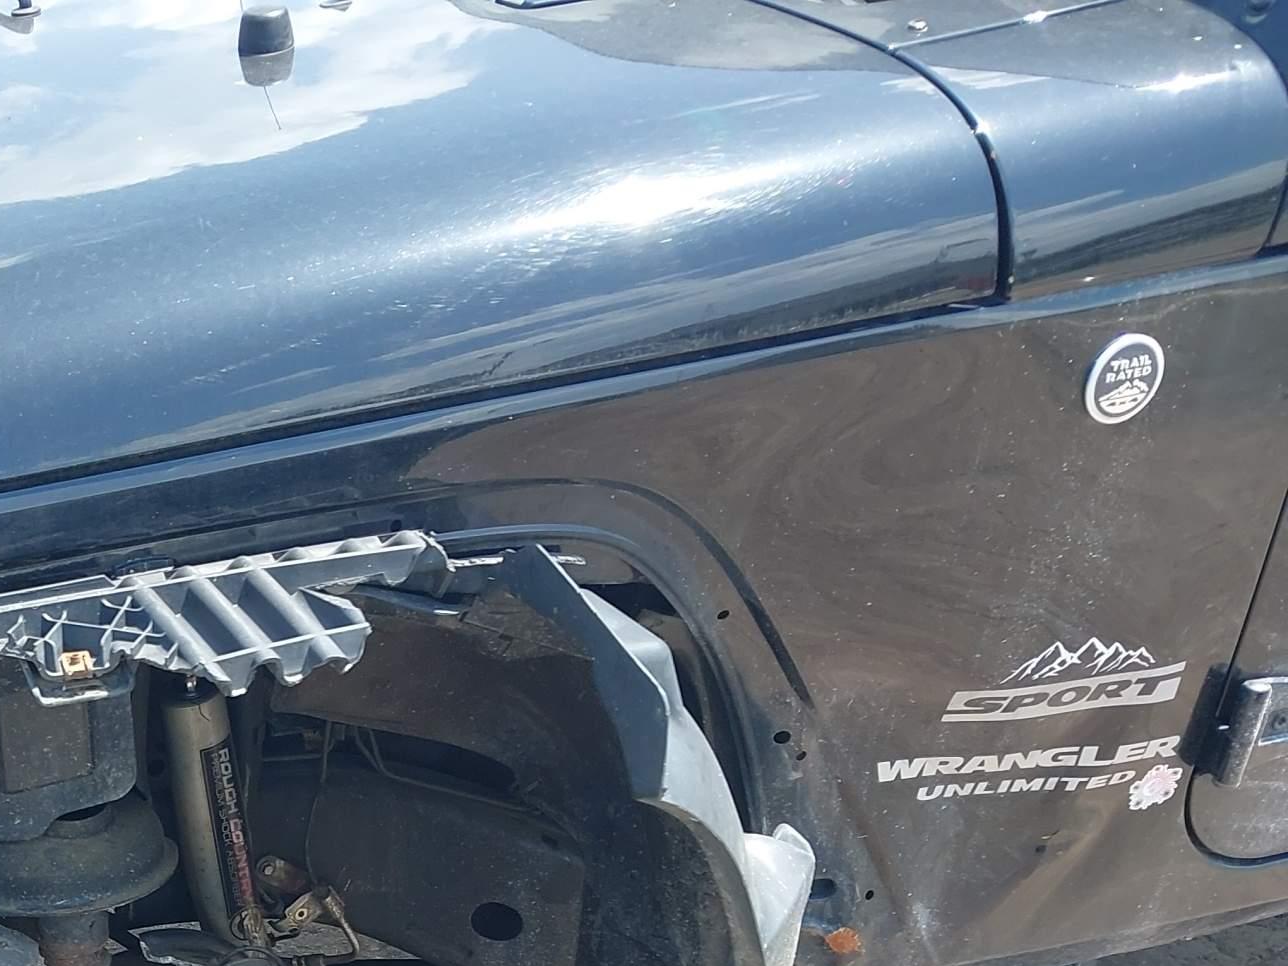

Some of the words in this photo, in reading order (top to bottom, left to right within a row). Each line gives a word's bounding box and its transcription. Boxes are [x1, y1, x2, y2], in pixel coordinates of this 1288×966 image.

[1105, 365, 1153, 384] RATED
[1110, 355, 1153, 371] TRAIL
[961, 677, 1166, 714] SPORT
[876, 735, 1182, 783] WRANGLER
[218, 748, 239, 814] ROUGH
[916, 770, 1137, 801] UNLIMITED
[219, 809, 233, 846] SHOCK
